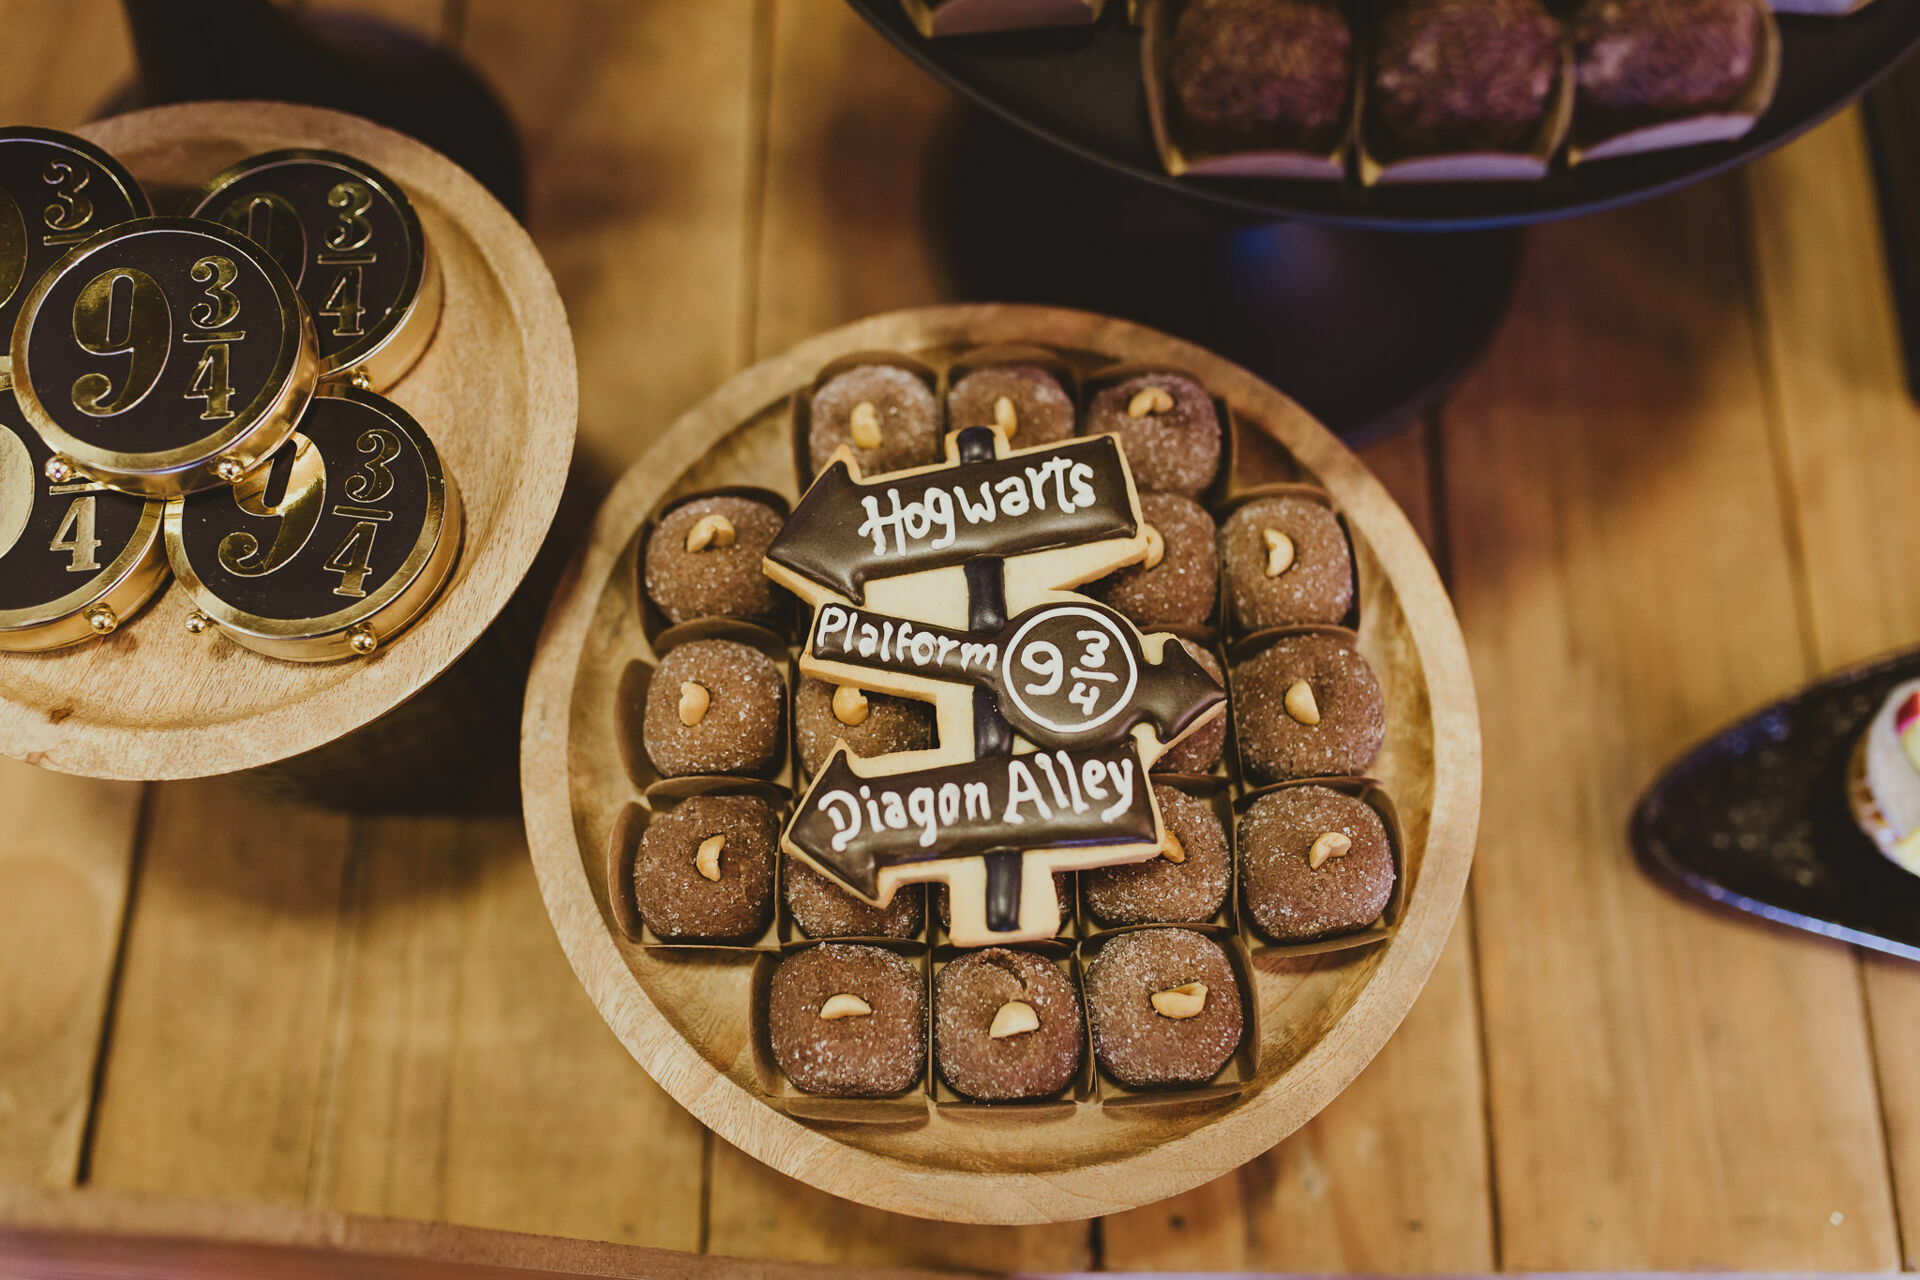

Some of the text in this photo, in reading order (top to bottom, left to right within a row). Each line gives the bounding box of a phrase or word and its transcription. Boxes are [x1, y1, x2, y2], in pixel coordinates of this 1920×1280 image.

[326, 182, 373, 251] 3
[71, 255, 241, 417] 9 3
[319, 265, 366, 336] 4
[184, 343, 236, 420] 4
[344, 428, 401, 503] 3
[49, 495, 102, 572] 4
[857, 456, 1097, 557] Hogwarts
[323, 521, 378, 597] 4
[1020, 640, 1064, 696] 9
[1076, 630, 1110, 668] 3
[1068, 682, 1100, 716] 4
[818, 749, 1134, 853] Diagon Alley
